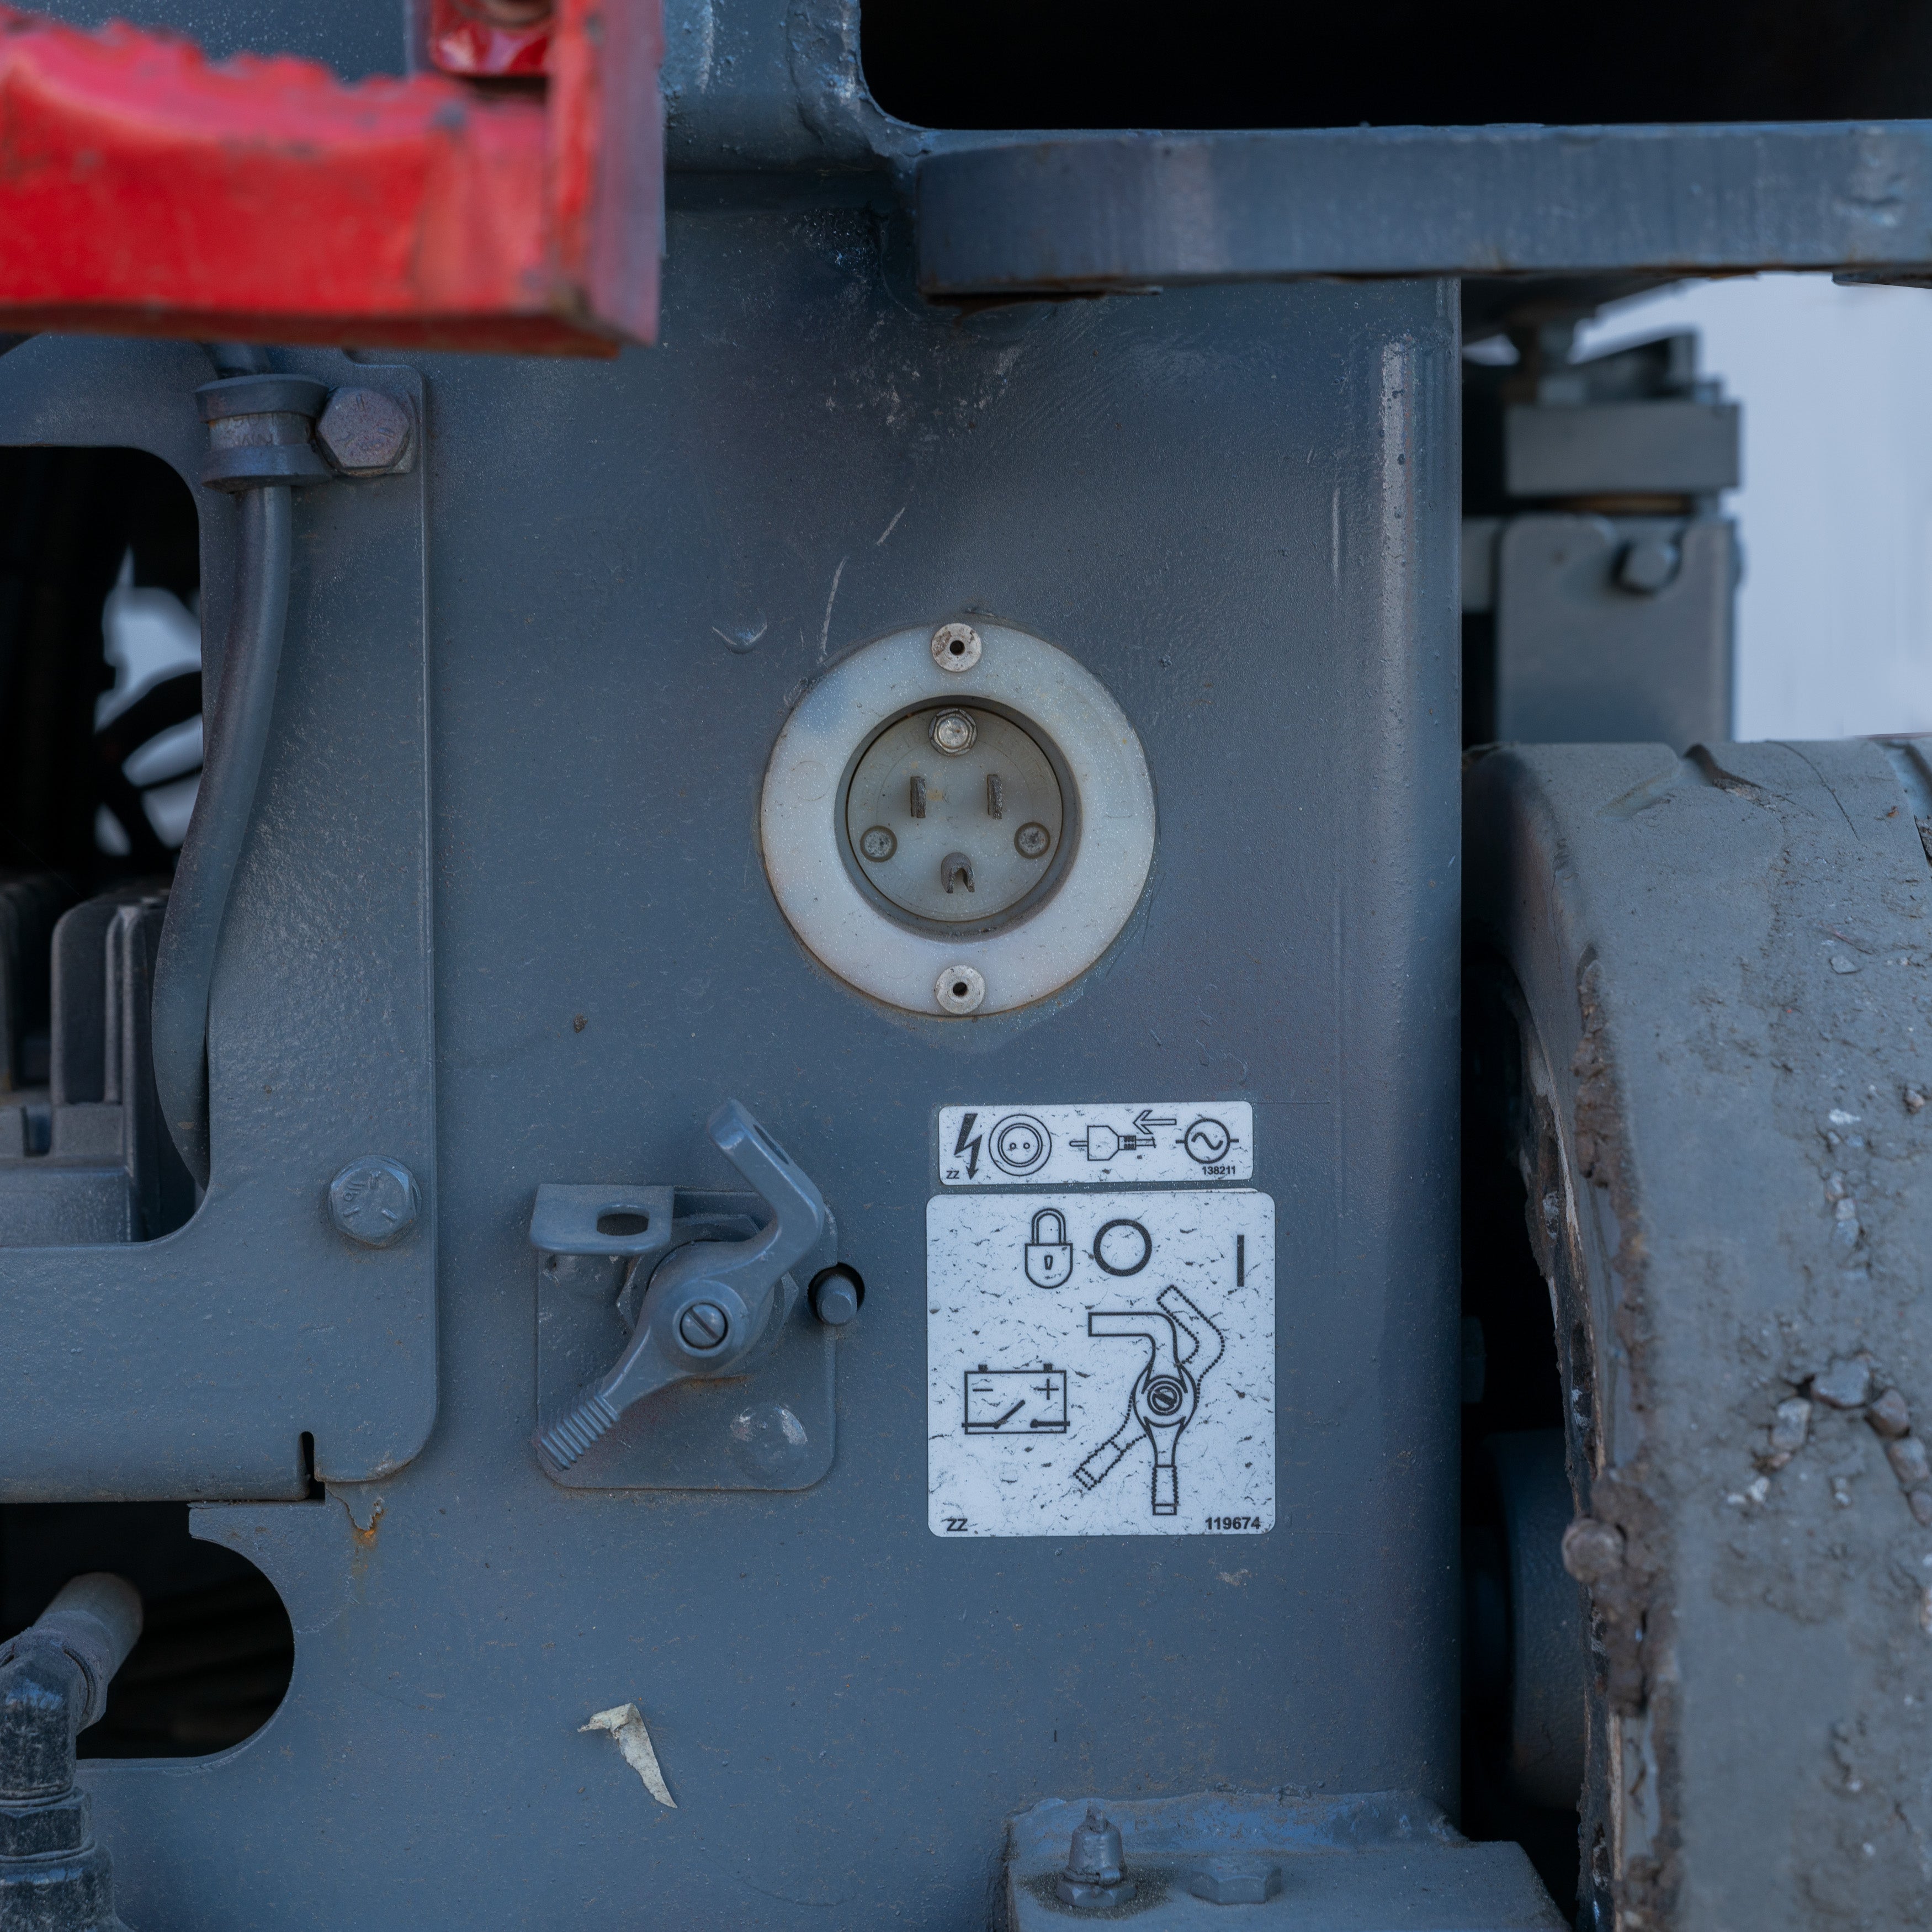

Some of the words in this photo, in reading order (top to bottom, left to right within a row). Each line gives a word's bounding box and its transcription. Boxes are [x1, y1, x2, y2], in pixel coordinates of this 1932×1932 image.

[946, 1170, 959, 1179] ZZ
[1202, 1166, 1236, 1175] 138211
[946, 1518, 968, 1531] ZZ
[1205, 1517, 1261, 1530] 119674
